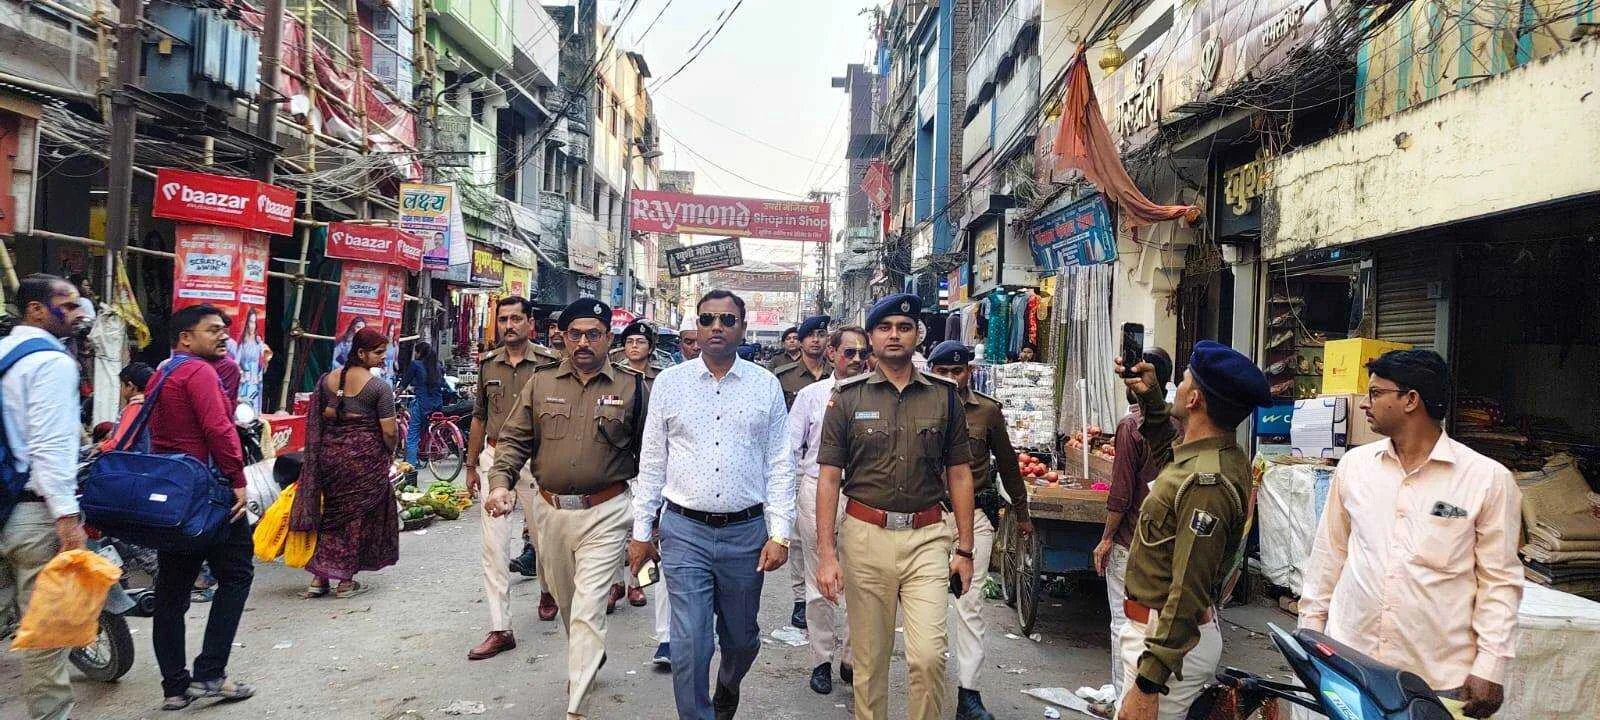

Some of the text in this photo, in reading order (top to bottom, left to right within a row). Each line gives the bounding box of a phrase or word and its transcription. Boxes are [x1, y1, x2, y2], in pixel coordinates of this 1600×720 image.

[181, 185, 250, 210] baazar
[402, 193, 446, 212] लक्ष्य
[632, 198, 750, 230] Raymond
[754, 212, 829, 230] Shop in Shop
[345, 233, 392, 249] baazar
[189, 258, 227, 268] SCRATCH
